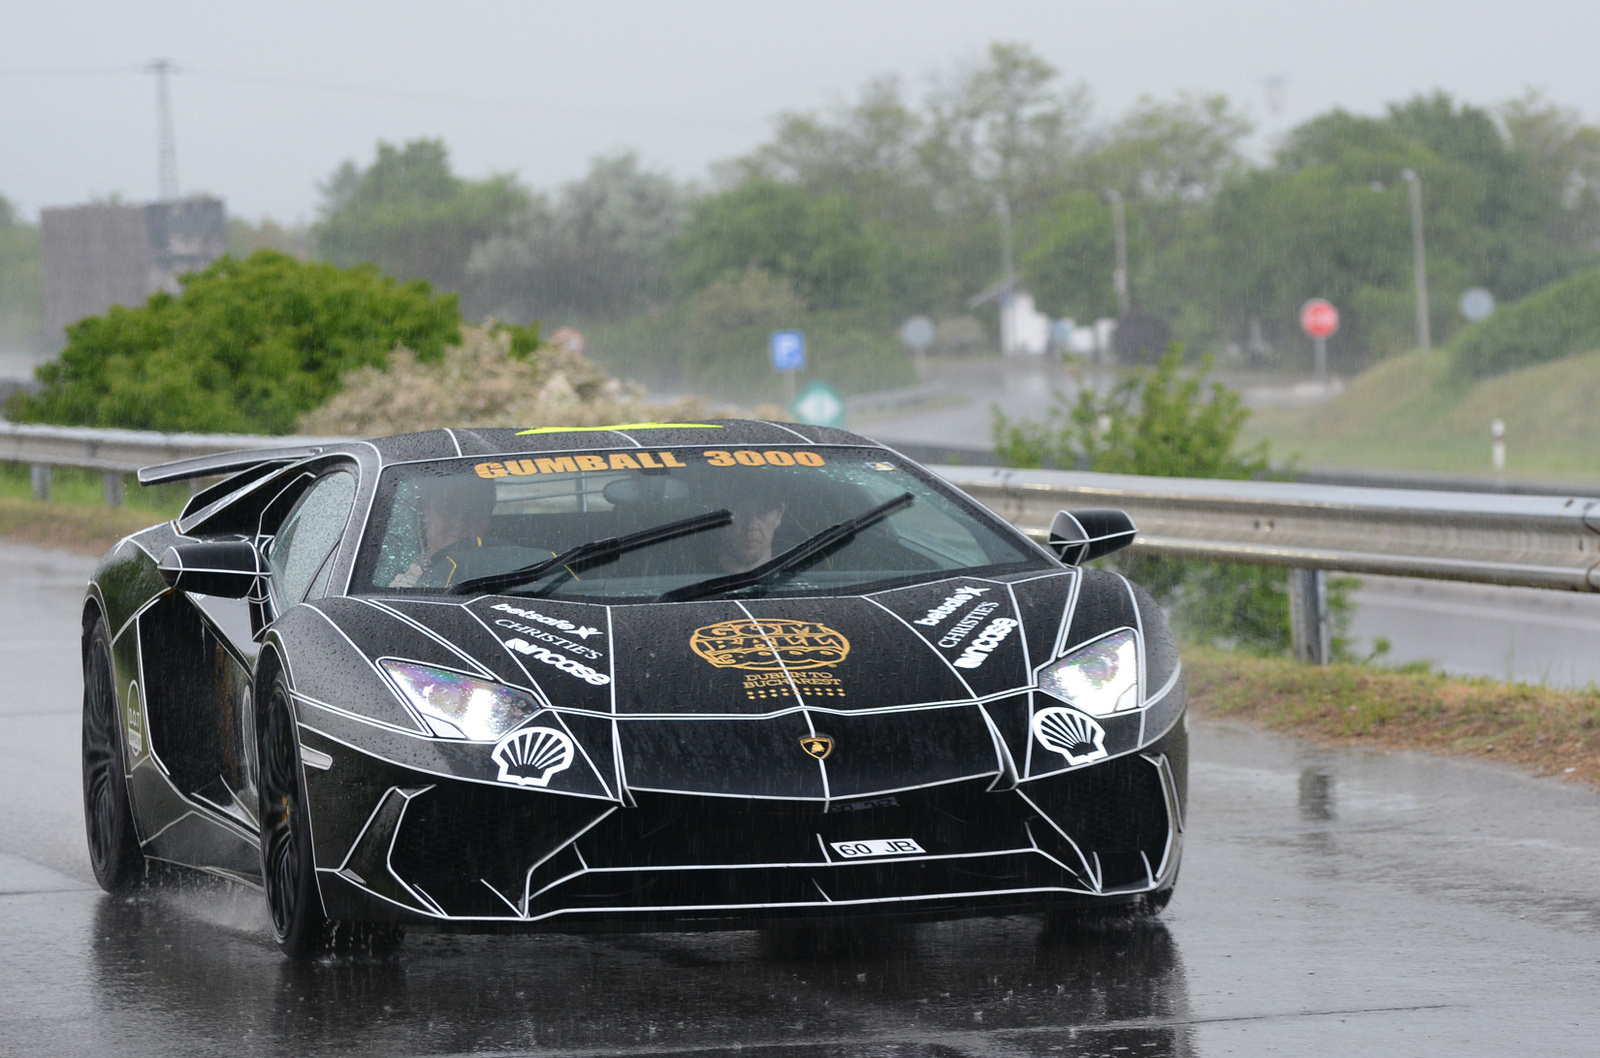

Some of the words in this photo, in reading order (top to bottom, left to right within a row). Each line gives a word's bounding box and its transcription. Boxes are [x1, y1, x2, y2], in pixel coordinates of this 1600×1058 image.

[474, 450, 687, 480] GUMBALL
[703, 450, 826, 468] 3000
[490, 603, 576, 630] betsafe
[913, 588, 974, 627] betsafe
[494, 619, 604, 660] CHRISTIE'S
[743, 678, 842, 689] BUCHAREST
[744, 672, 808, 682] DUBLIN
[839, 844, 872, 856] 60
[886, 841, 917, 852] JB
